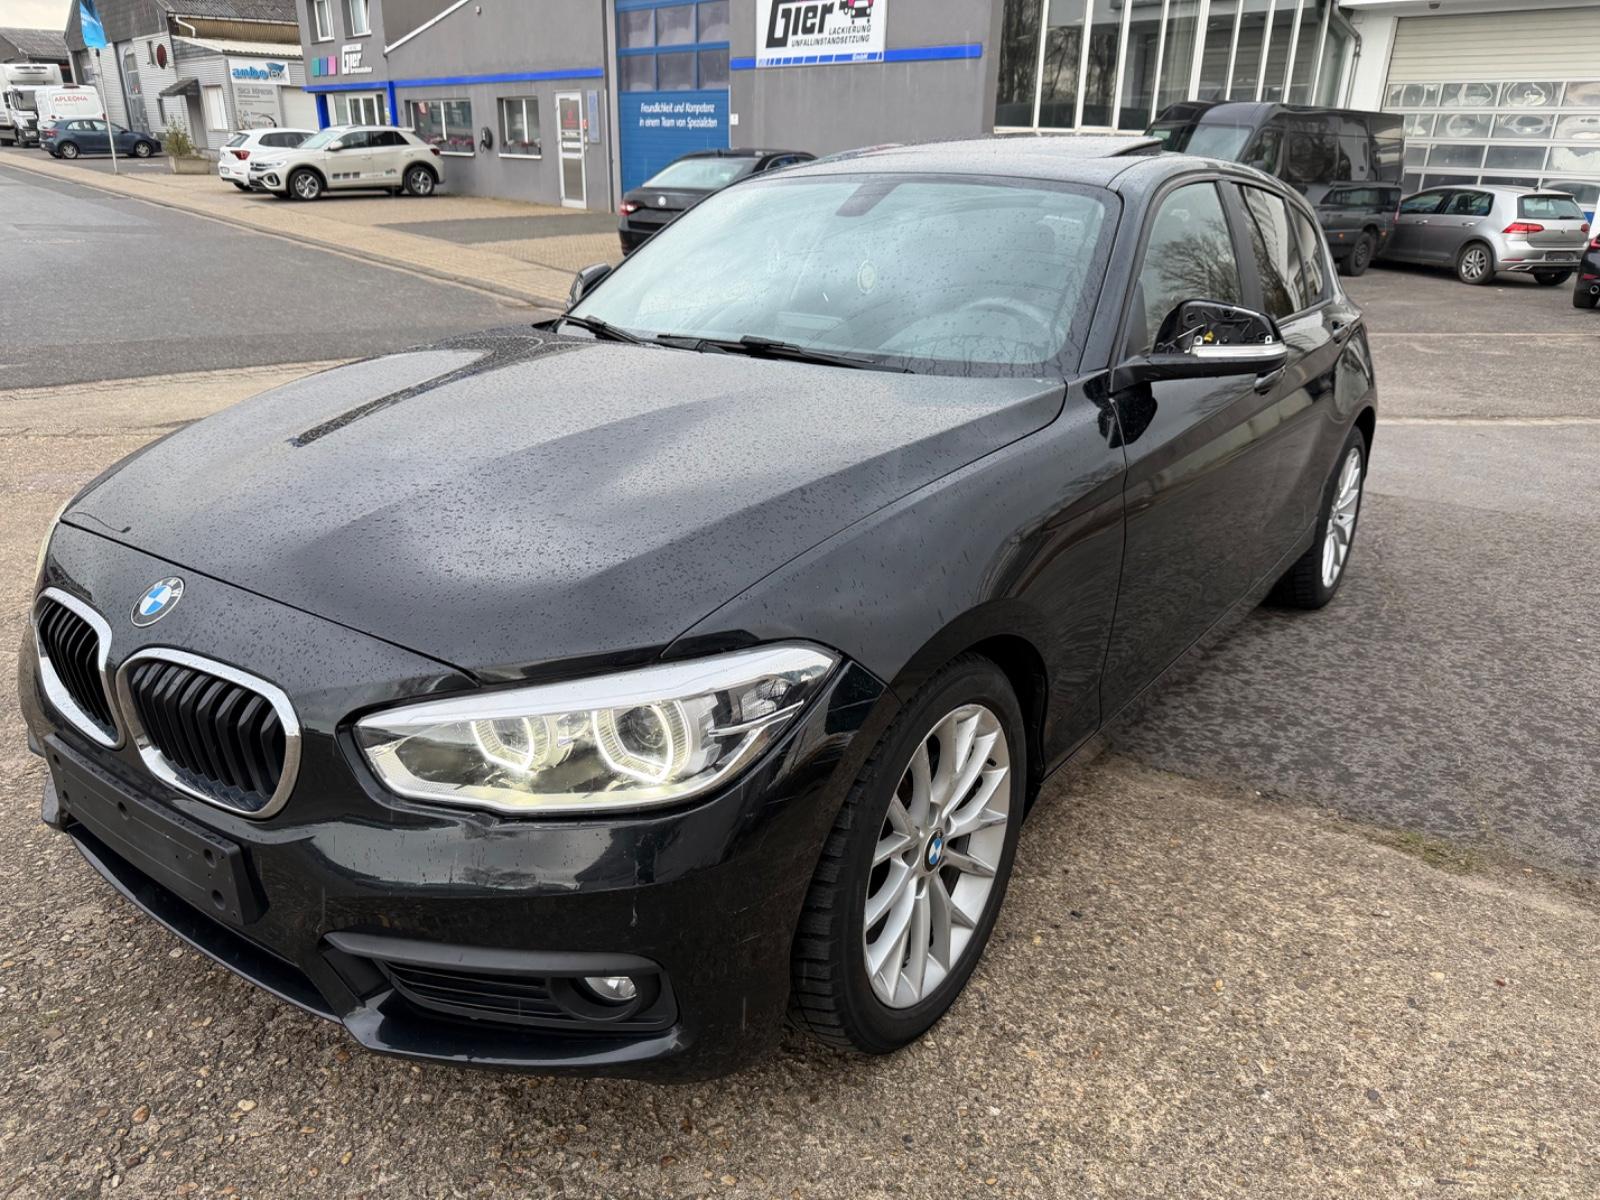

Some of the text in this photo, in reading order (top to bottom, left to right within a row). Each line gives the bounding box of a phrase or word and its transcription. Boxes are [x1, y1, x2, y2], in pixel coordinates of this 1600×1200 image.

[829, 24, 872, 36] LACKIERUNG
[791, 34, 871, 47] UNFALLINSTANDSETZUNG
[640, 102, 715, 115] Freundlichkeit und Kompetenz
[645, 117, 661, 128] einem
[661, 116, 675, 128] Team
[676, 119, 686, 128] von
[687, 116, 718, 131] Spezialisten
